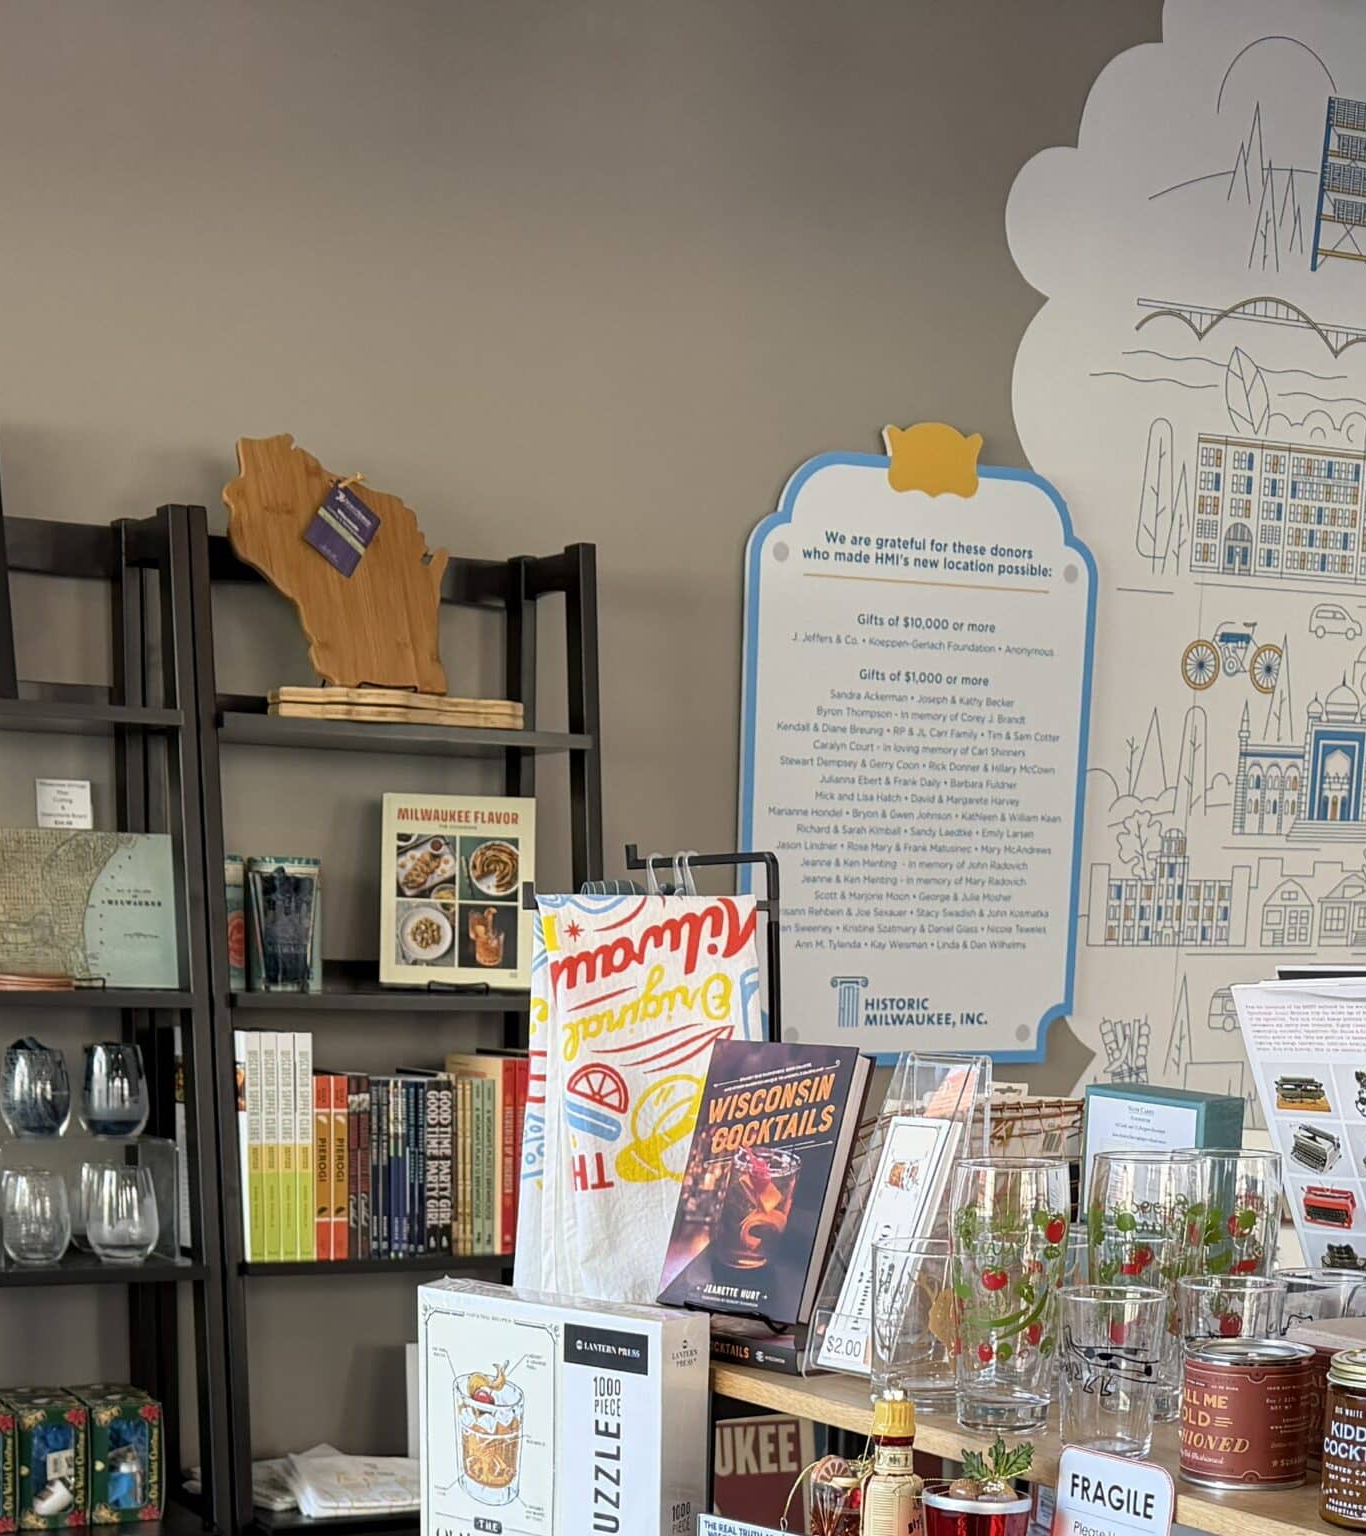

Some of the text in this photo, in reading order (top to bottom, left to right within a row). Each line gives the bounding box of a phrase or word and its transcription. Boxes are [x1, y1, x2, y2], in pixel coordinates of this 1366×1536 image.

[825, 530, 1033, 559] We are grateful for these donors
[802, 548, 1052, 578] who made HMI's new location possible:
[857, 613, 996, 633] Gifts of $10,000 or more
[947, 641, 996, 653] Foundation
[859, 668, 989, 687] Gifts of $1,000 or more
[397, 807, 519, 825] MILWAUKEE FLAVOR
[563, 964, 733, 1062] Original
[864, 997, 929, 1011] HISTORIC
[864, 1013, 988, 1028] MILWAUKEE, INC.
[709, 1074, 836, 1124] WISCONSIN
[711, 1105, 836, 1153] COCKTAILS
[318, 1137, 327, 1183] PIEROGI
[336, 1137, 345, 1183] PIEROGI
[426, 1090, 438, 1228] GOOD TIME PARTY GIRL
[439, 1090, 452, 1228] GOOD TIME PARTY GIRL
[703, 1283, 761, 1301] JEANETTE HURT
[584, 1341, 641, 1359] LANTERN PRESS
[826, 1335, 862, 1358] $2.00
[593, 1376, 621, 1397] 1000
[594, 1398, 621, 1417] PIECE
[1204, 1392, 1229, 1409] ME
[715, 1424, 797, 1476] UKEE
[1070, 1473, 1155, 1521] FRAGILE
[672, 1500, 691, 1521] 1000
[478, 1519, 499, 1533] THE
[672, 1518, 690, 1534] PIECE
[704, 1519, 717, 1531] THE
[718, 1522, 737, 1535] REAL
